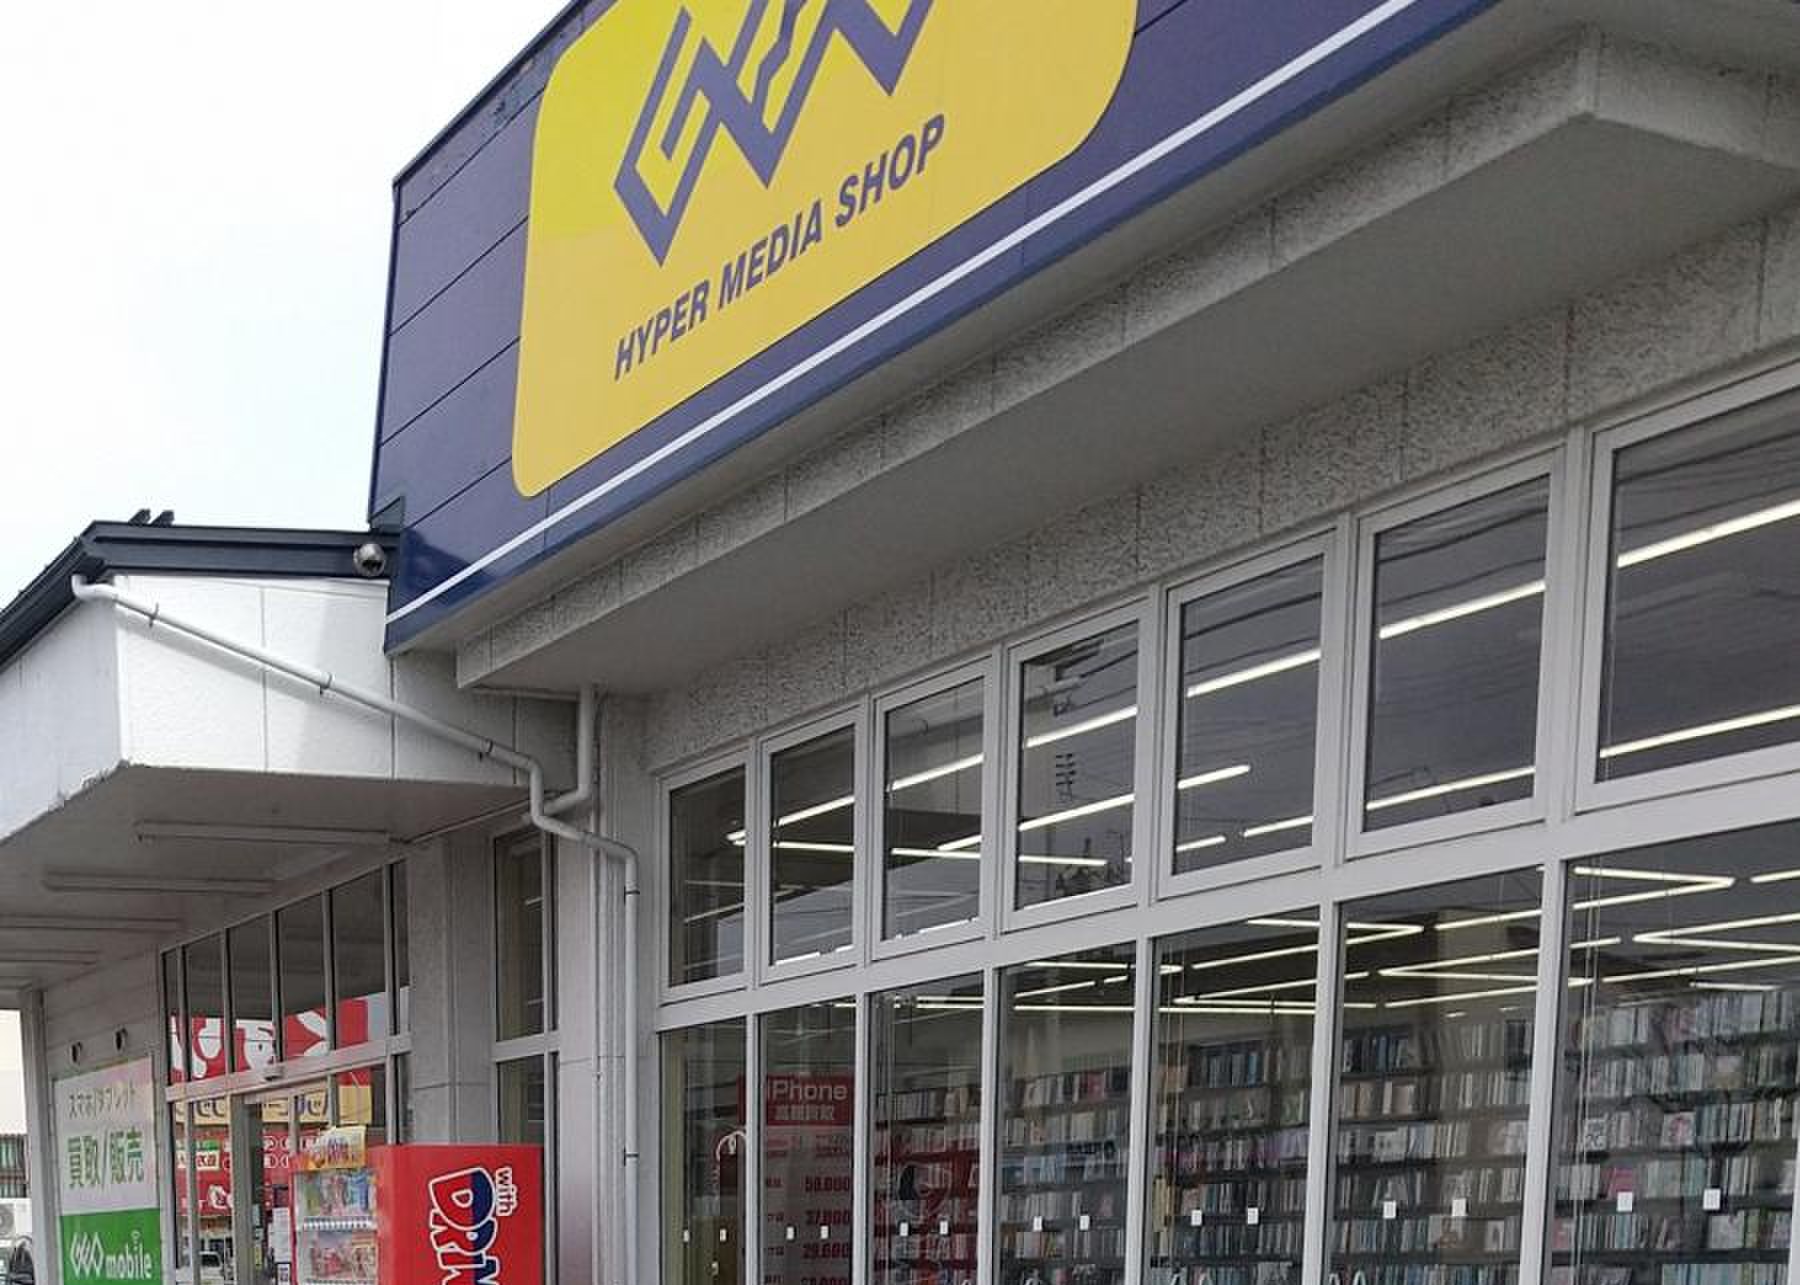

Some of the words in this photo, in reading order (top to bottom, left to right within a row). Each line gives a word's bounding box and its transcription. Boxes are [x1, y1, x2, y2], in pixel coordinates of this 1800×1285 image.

[613, 280, 710, 381] HYPER
[717, 199, 823, 311] MEDIA
[834, 113, 946, 229] SHOP
[495, 1167, 518, 1217] with
[105, 1238, 152, 1279] mobile
